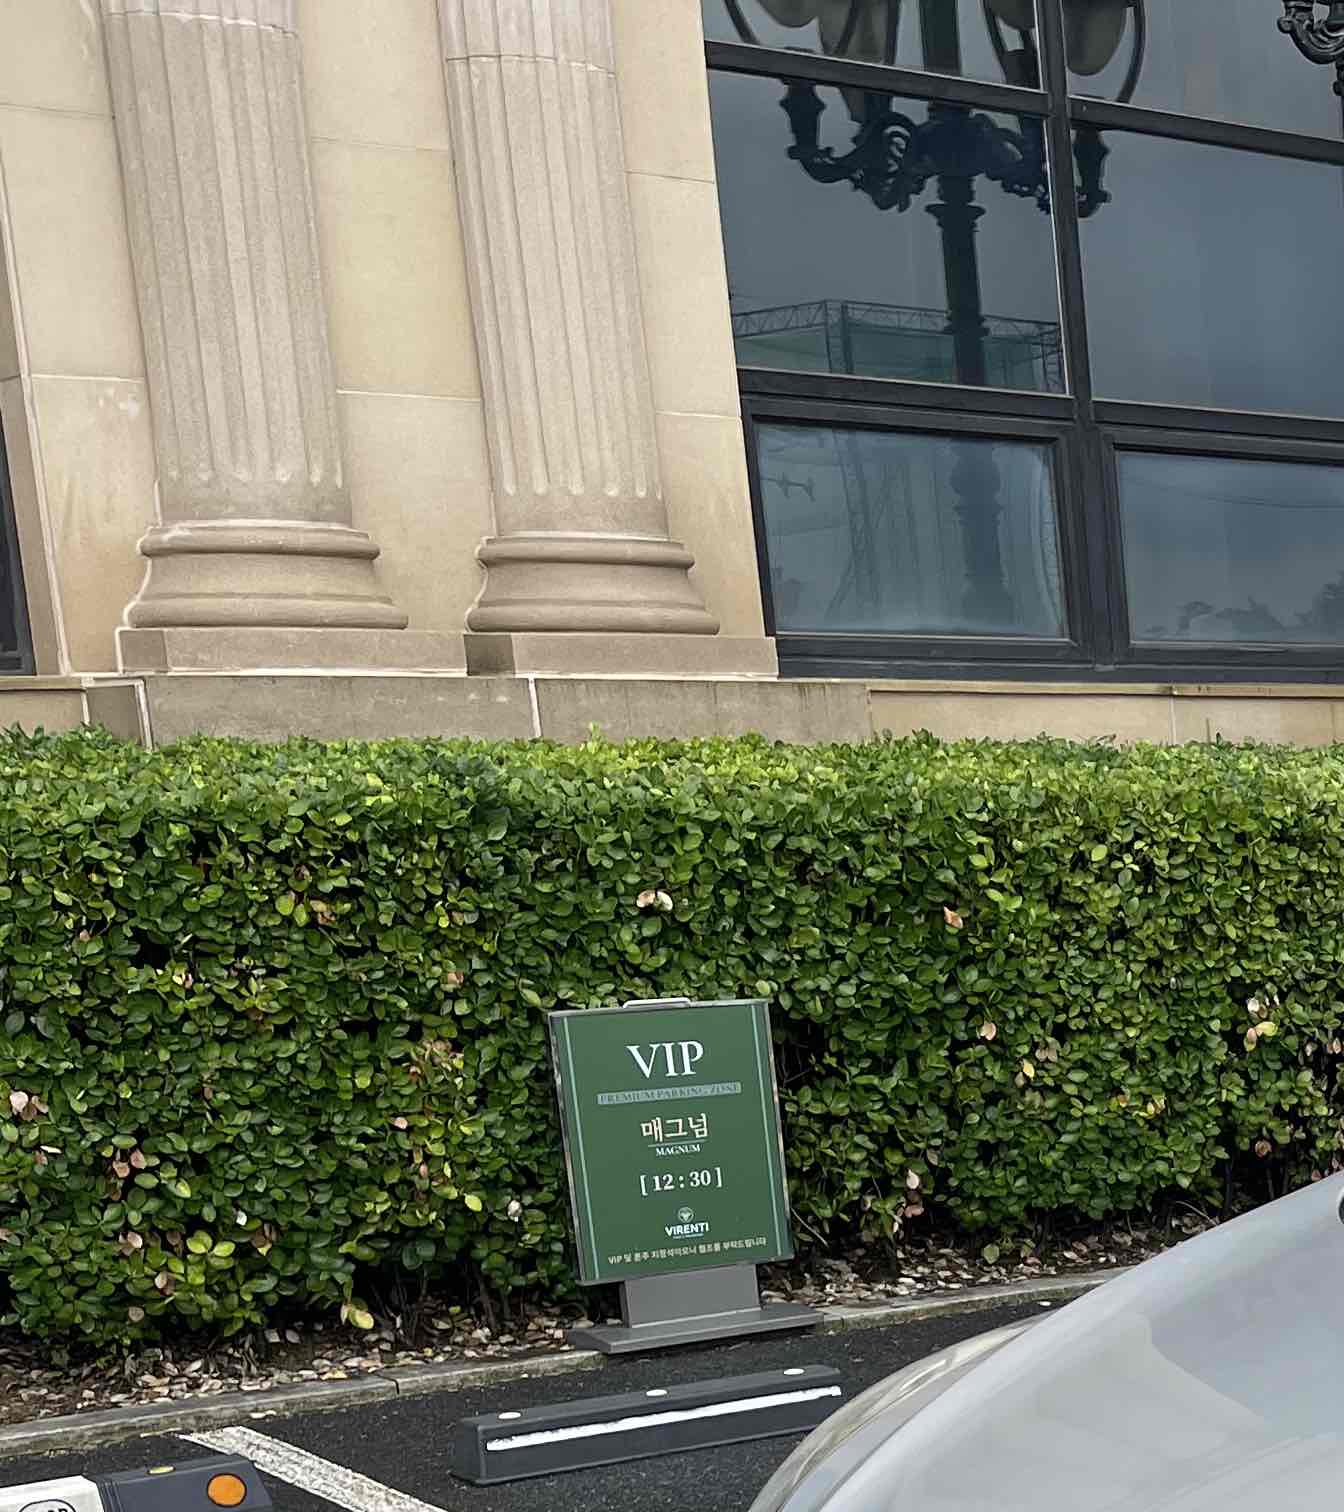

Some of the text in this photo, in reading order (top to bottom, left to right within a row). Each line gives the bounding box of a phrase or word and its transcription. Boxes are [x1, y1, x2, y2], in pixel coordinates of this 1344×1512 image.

[627, 1040, 704, 1079] VIP
[640, 1113, 708, 1142] 매그넘
[655, 1144, 702, 1157] MAGNUM
[665, 1222, 710, 1238] VIRENTI
[608, 1255, 623, 1265] VIP
